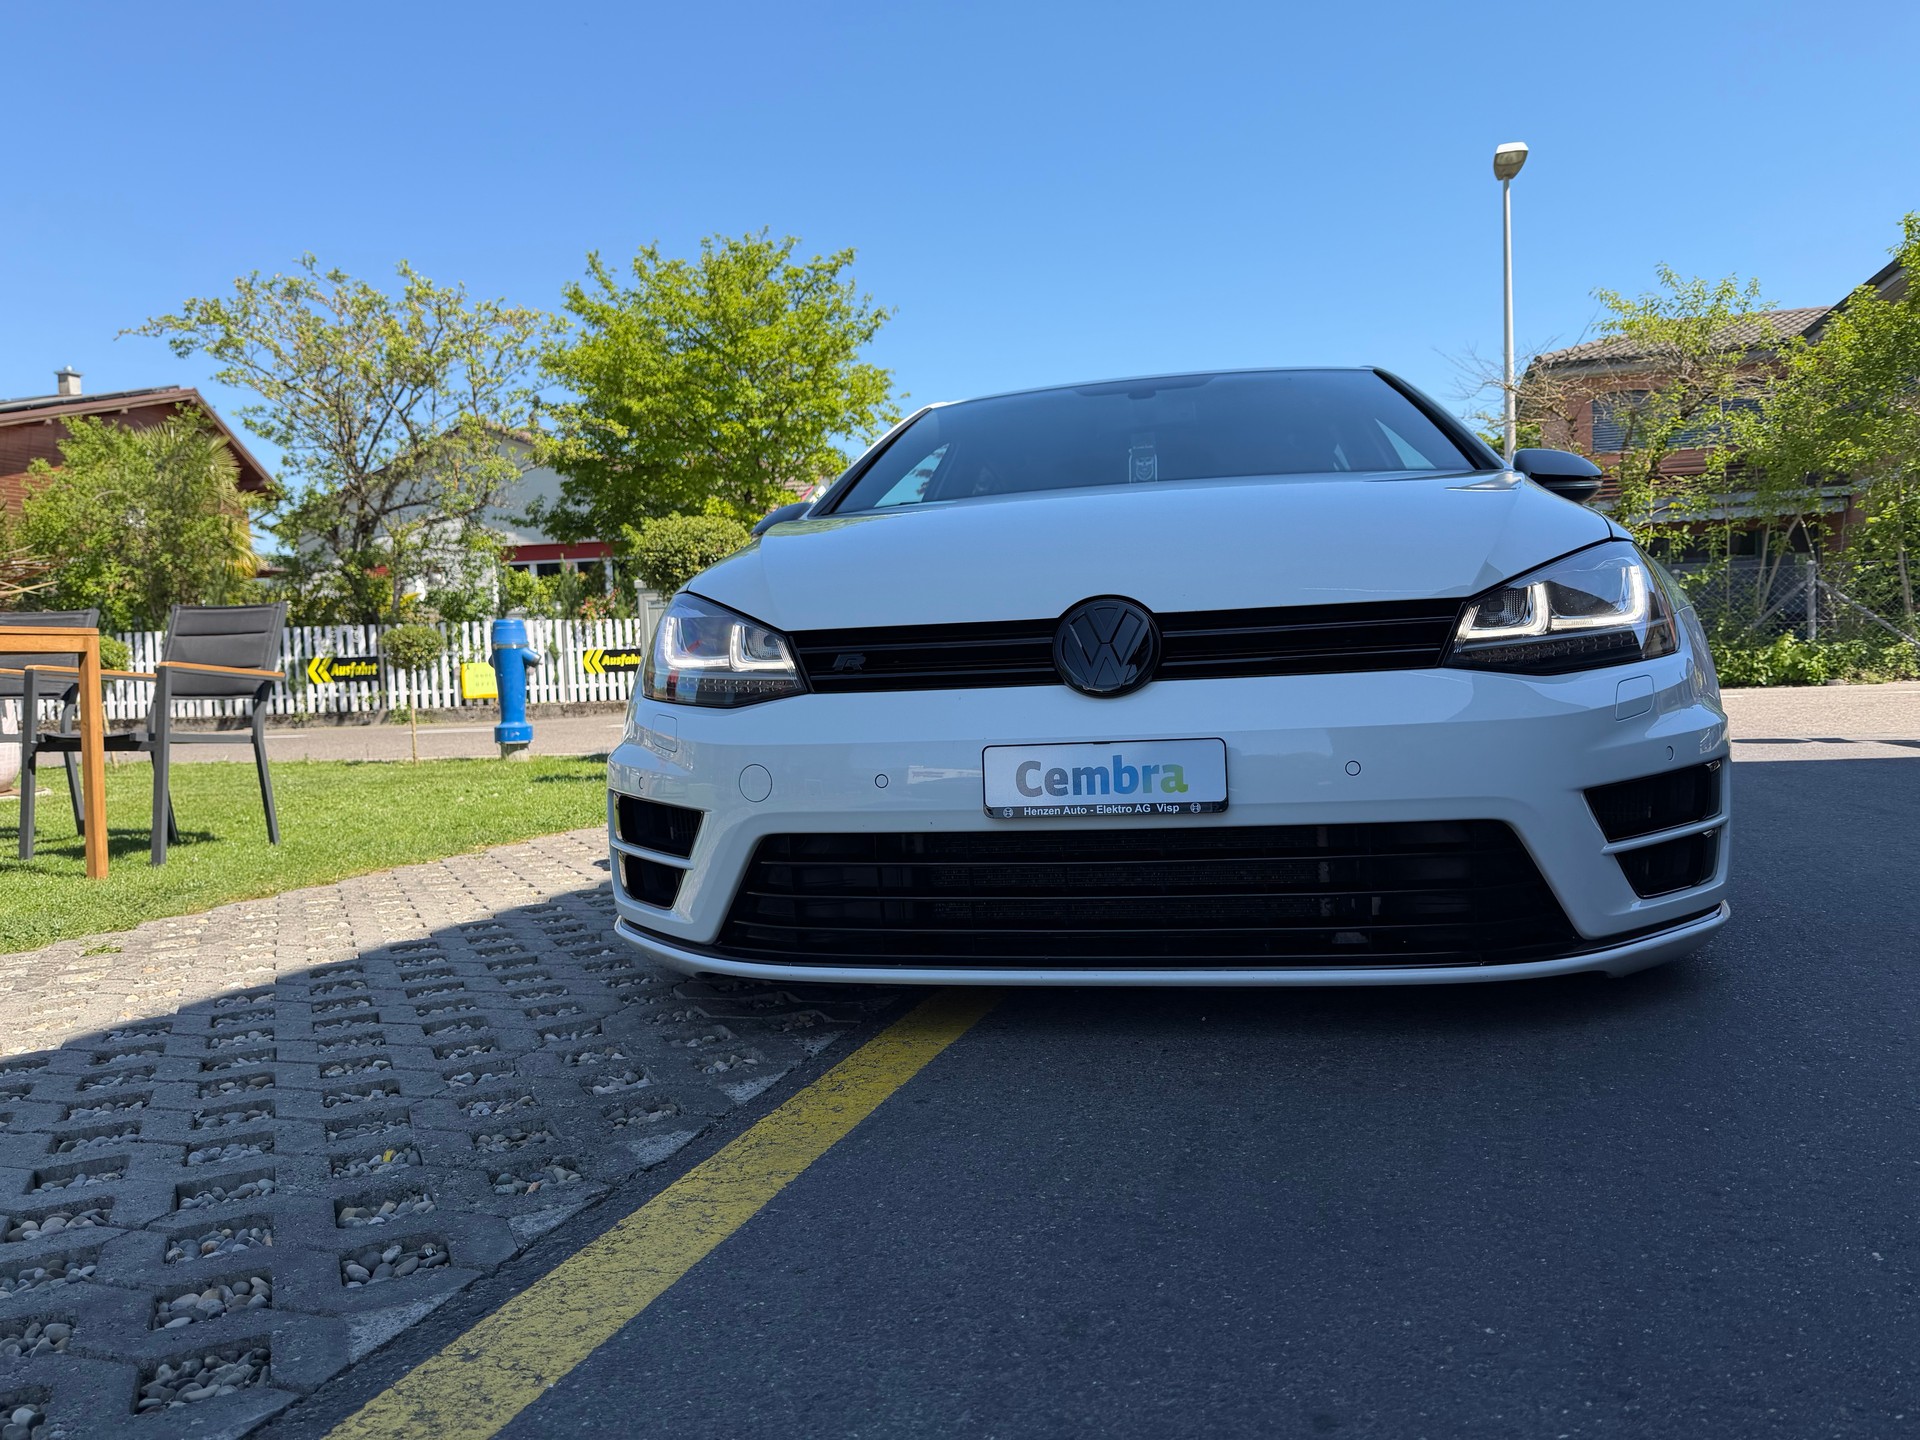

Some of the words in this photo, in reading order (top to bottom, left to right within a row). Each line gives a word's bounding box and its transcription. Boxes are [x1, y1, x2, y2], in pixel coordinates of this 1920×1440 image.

[331, 661, 377, 678] Ausfahrt
[1015, 755, 1188, 797] Cembra
[1023, 806, 1061, 816] Henzen
[1062, 805, 1087, 815] Auto
[1096, 804, 1133, 814] Elektro
[1134, 803, 1151, 813] AG
[1156, 803, 1180, 814] Visp
